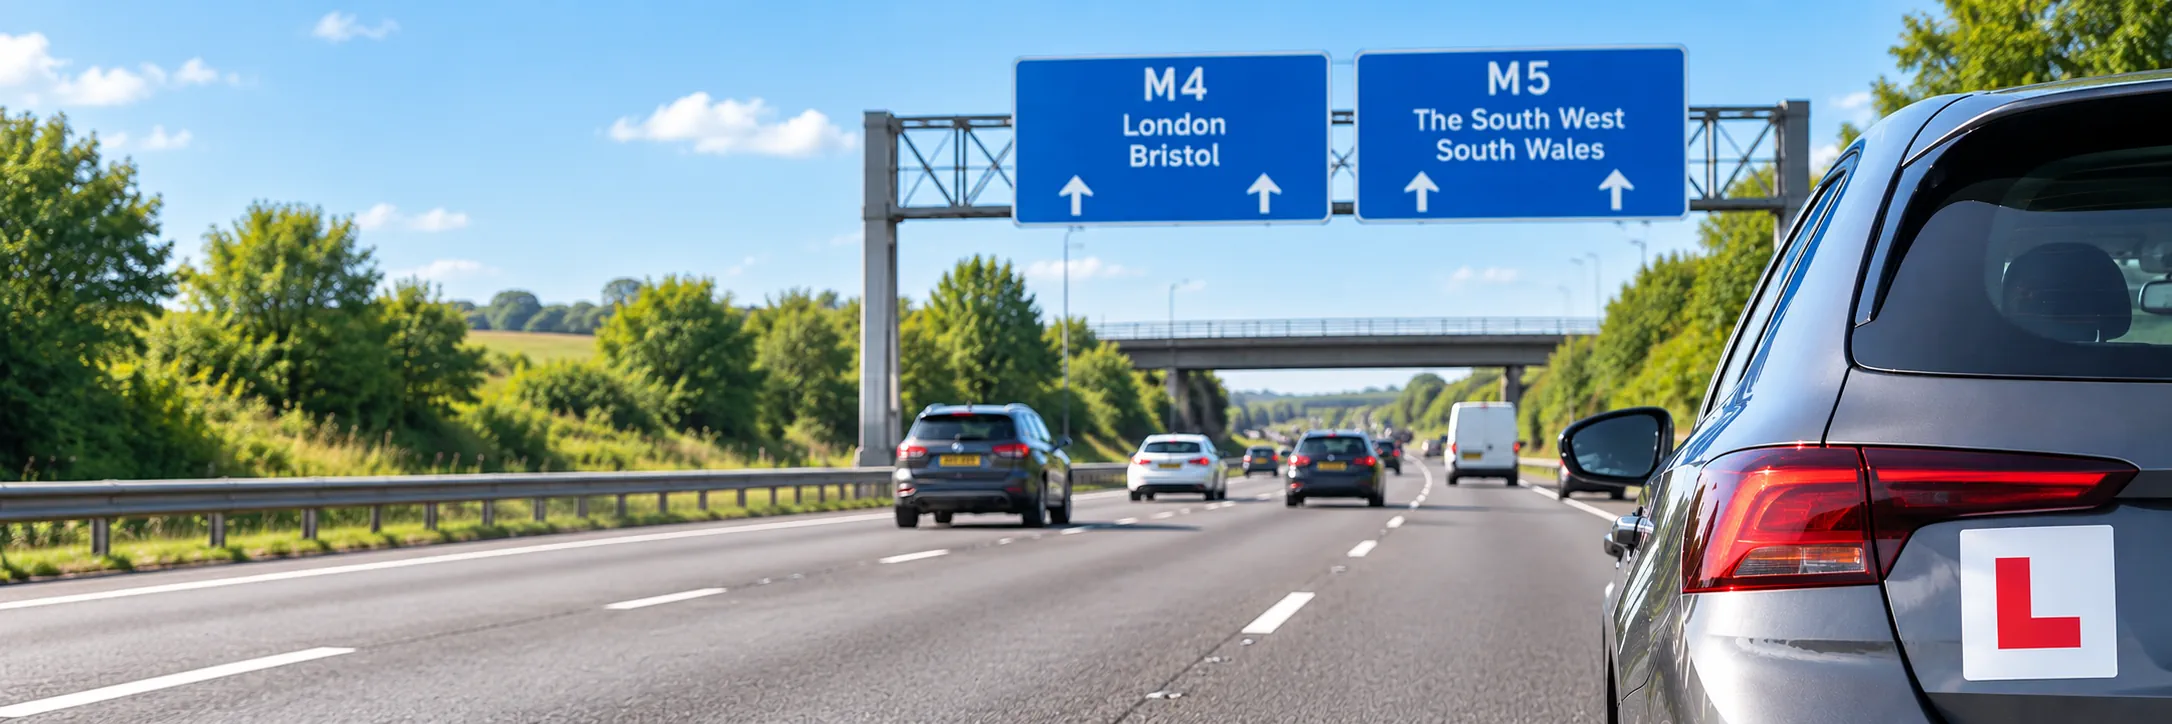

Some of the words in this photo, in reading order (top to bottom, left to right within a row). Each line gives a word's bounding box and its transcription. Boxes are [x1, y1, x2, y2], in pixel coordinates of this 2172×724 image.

[1145, 66, 1207, 101] M4
[1488, 61, 1550, 95] M5
[1123, 112, 1226, 136] London
[1413, 107, 1463, 131] The
[1471, 107, 1550, 131] South
[1559, 107, 1625, 131] West
[1130, 143, 1220, 167] Bristol
[1437, 137, 1515, 161] South
[1525, 137, 1605, 161] Wales
[1996, 558, 2081, 650] L
